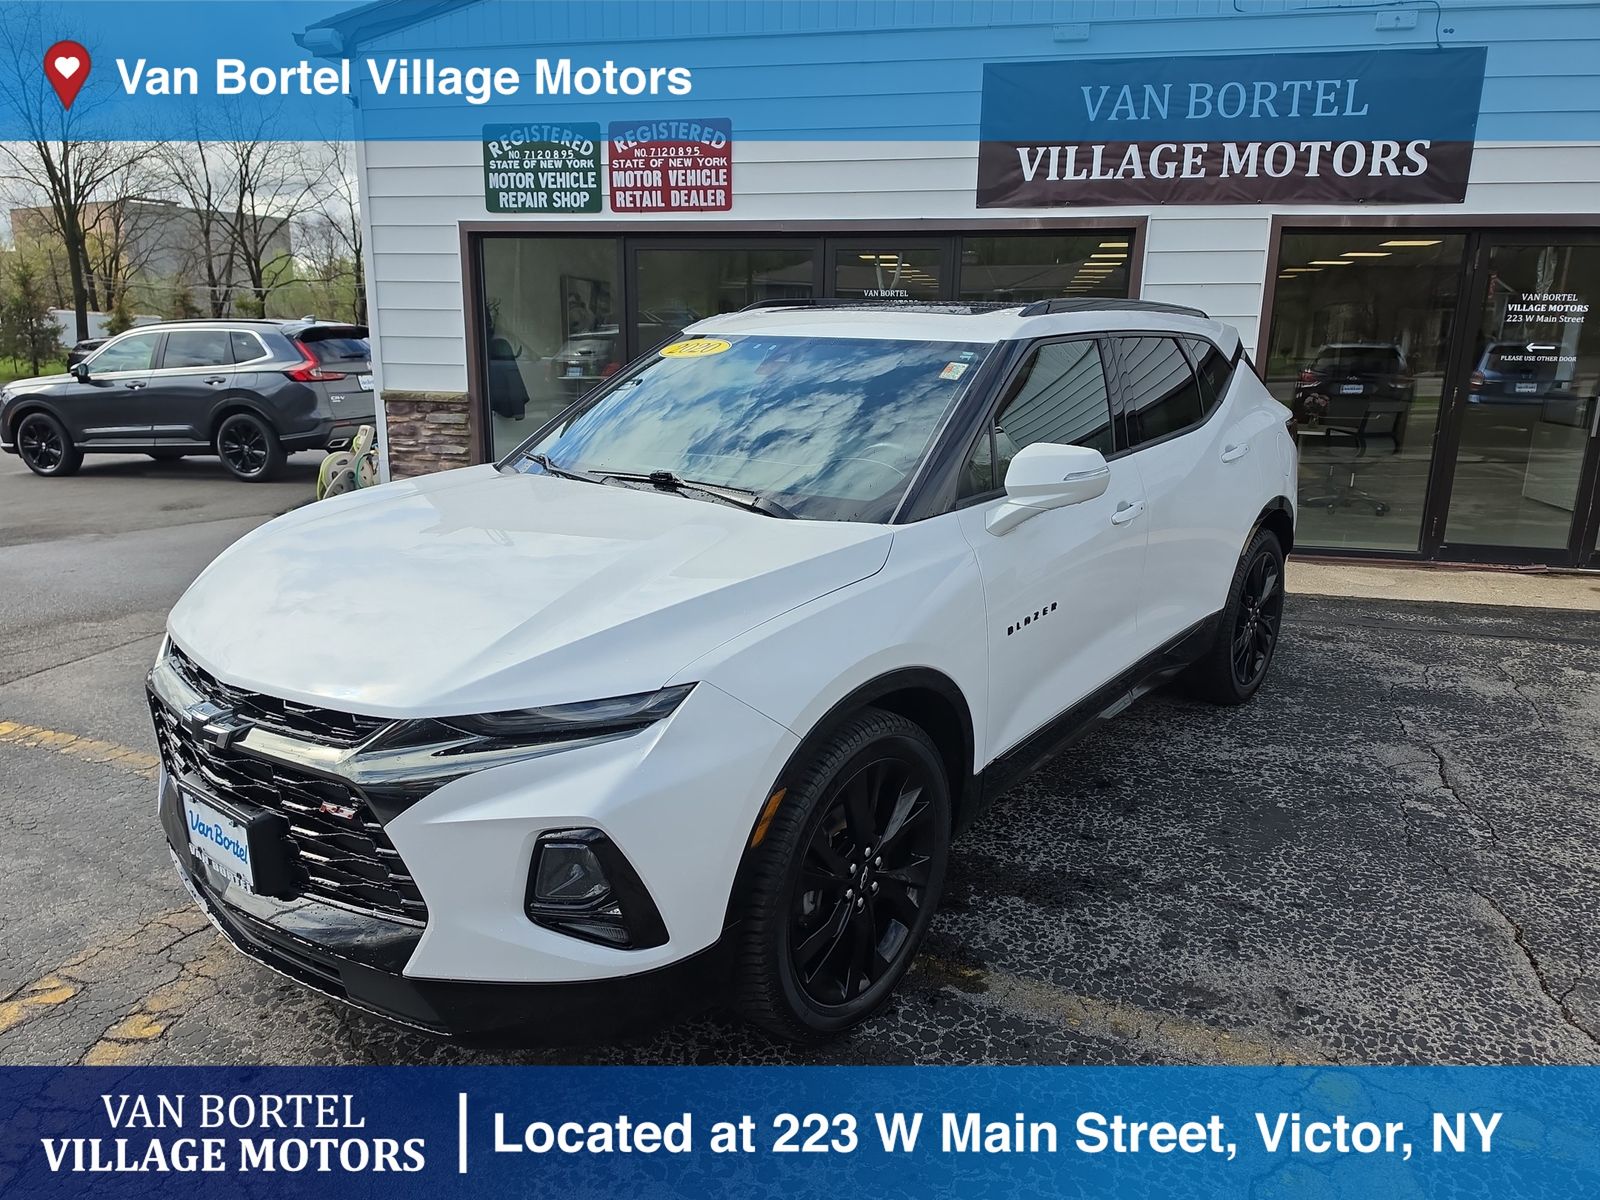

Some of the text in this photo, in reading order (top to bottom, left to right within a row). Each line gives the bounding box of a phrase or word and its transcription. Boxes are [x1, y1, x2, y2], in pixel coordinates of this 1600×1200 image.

[1080, 78, 1369, 121] VAN BORTEL
[488, 124, 595, 158] REGISTERED
[613, 121, 727, 154] REGISTERED
[508, 150, 575, 159] NO. 7120895
[634, 146, 701, 158] NO. 7120895
[1016, 139, 1431, 182] VILLAGE MOTORS
[489, 159, 595, 169] STATE OF NEW YORK
[612, 157, 728, 168] STATE OF NEW YORK
[488, 171, 597, 189] MOTOR VEHICLE
[612, 169, 728, 188] MOTOR VEHICLE
[499, 191, 590, 208] REPAIR SHOP
[615, 190, 726, 208] RETAIL DEALER
[863, 289, 909, 297] VAN BORTEL
[1522, 293, 1578, 301] VAN BORTEL
[1507, 304, 1589, 312] VILLAGE MOTORS
[1558, 315, 1585, 323] Street
[1007, 601, 1058, 636] BLAZER
[188, 810, 248, 865] Van Bortel
